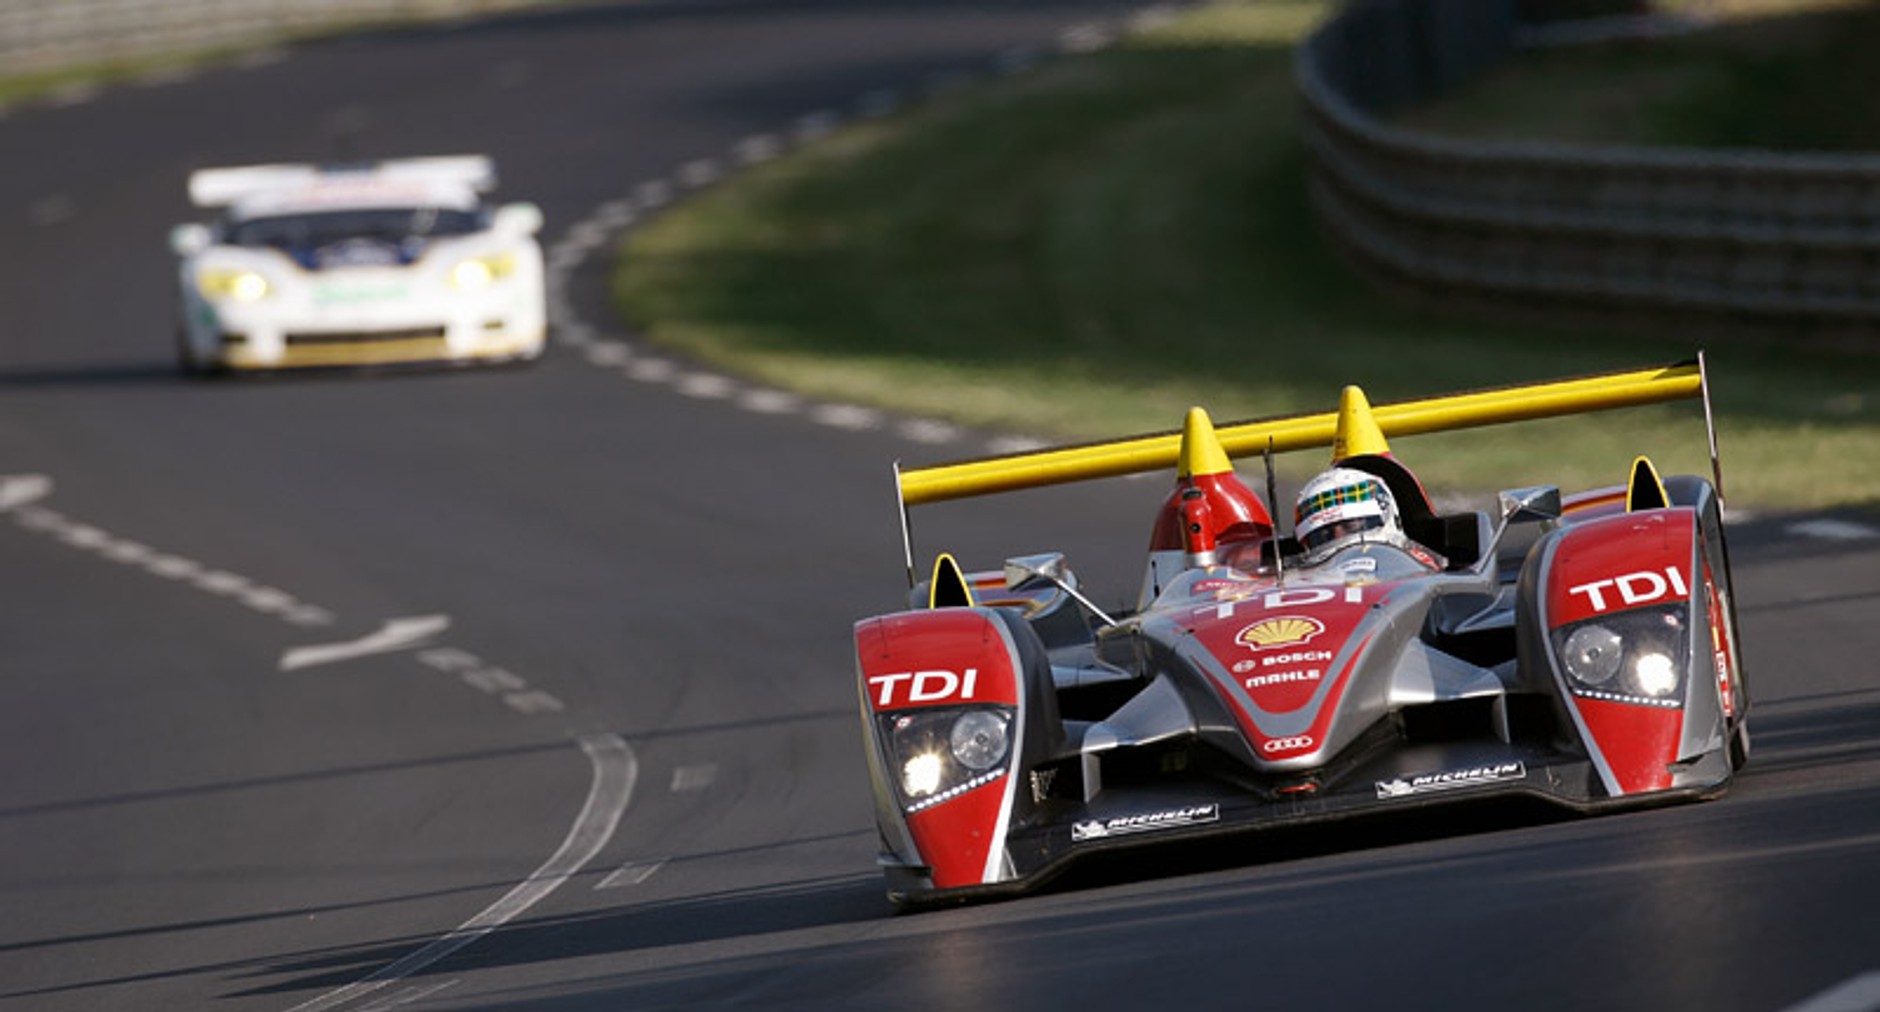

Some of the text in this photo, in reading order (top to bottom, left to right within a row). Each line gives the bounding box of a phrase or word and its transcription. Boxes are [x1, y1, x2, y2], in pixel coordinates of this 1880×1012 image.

[1193, 586, 1362, 619] TDI
[1569, 565, 1688, 612] TDI
[1262, 651, 1332, 667] BOSCH
[869, 668, 978, 705] TDI
[1246, 669, 1321, 688] MAHLE
